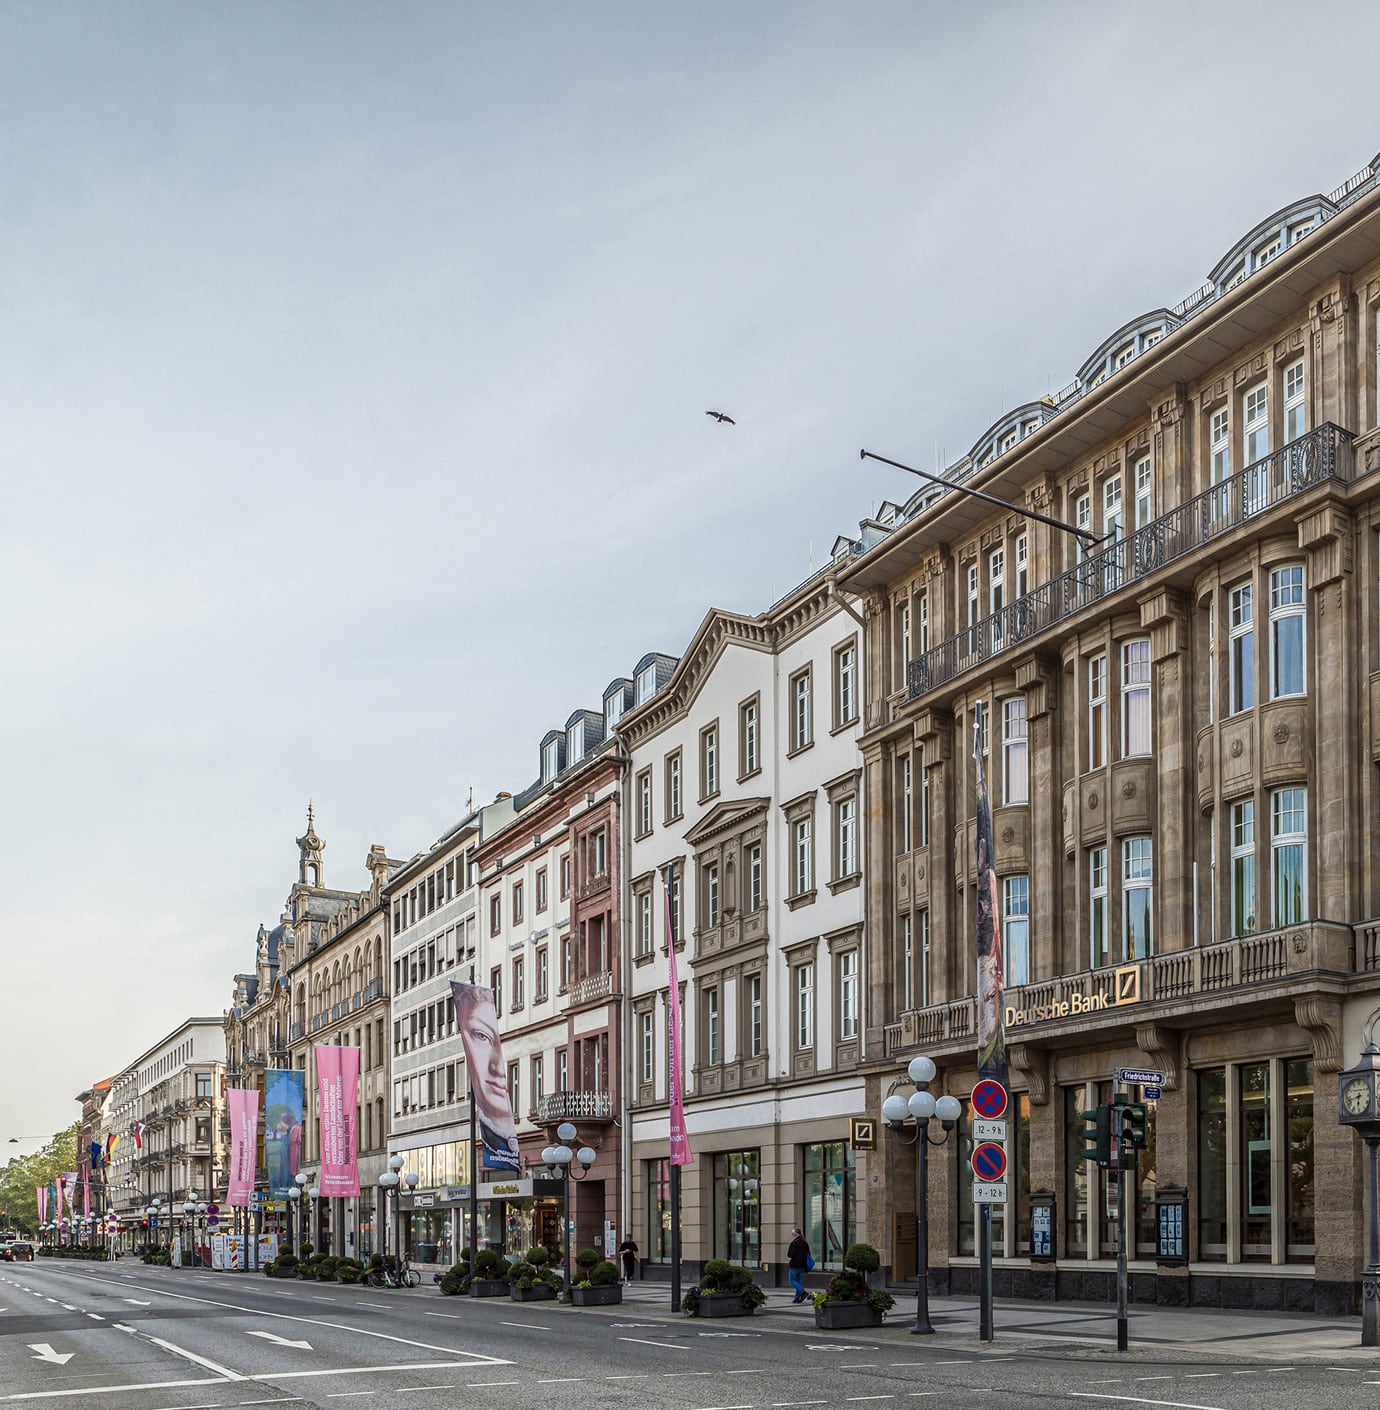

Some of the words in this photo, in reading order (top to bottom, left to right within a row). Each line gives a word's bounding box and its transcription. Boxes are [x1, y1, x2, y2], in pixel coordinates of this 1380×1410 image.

[1005, 998, 1068, 1027] Deutsche
[1072, 988, 1108, 1014] Bank
[1125, 1072, 1160, 1081] Friedrichstraße
[978, 1125, 984, 1134] 12
[992, 1126, 996, 1134] 9
[998, 1126, 1002, 1134] h
[978, 1188, 982, 1197] 9
[990, 1188, 996, 1198] 12
[999, 1189, 1002, 1198] h
